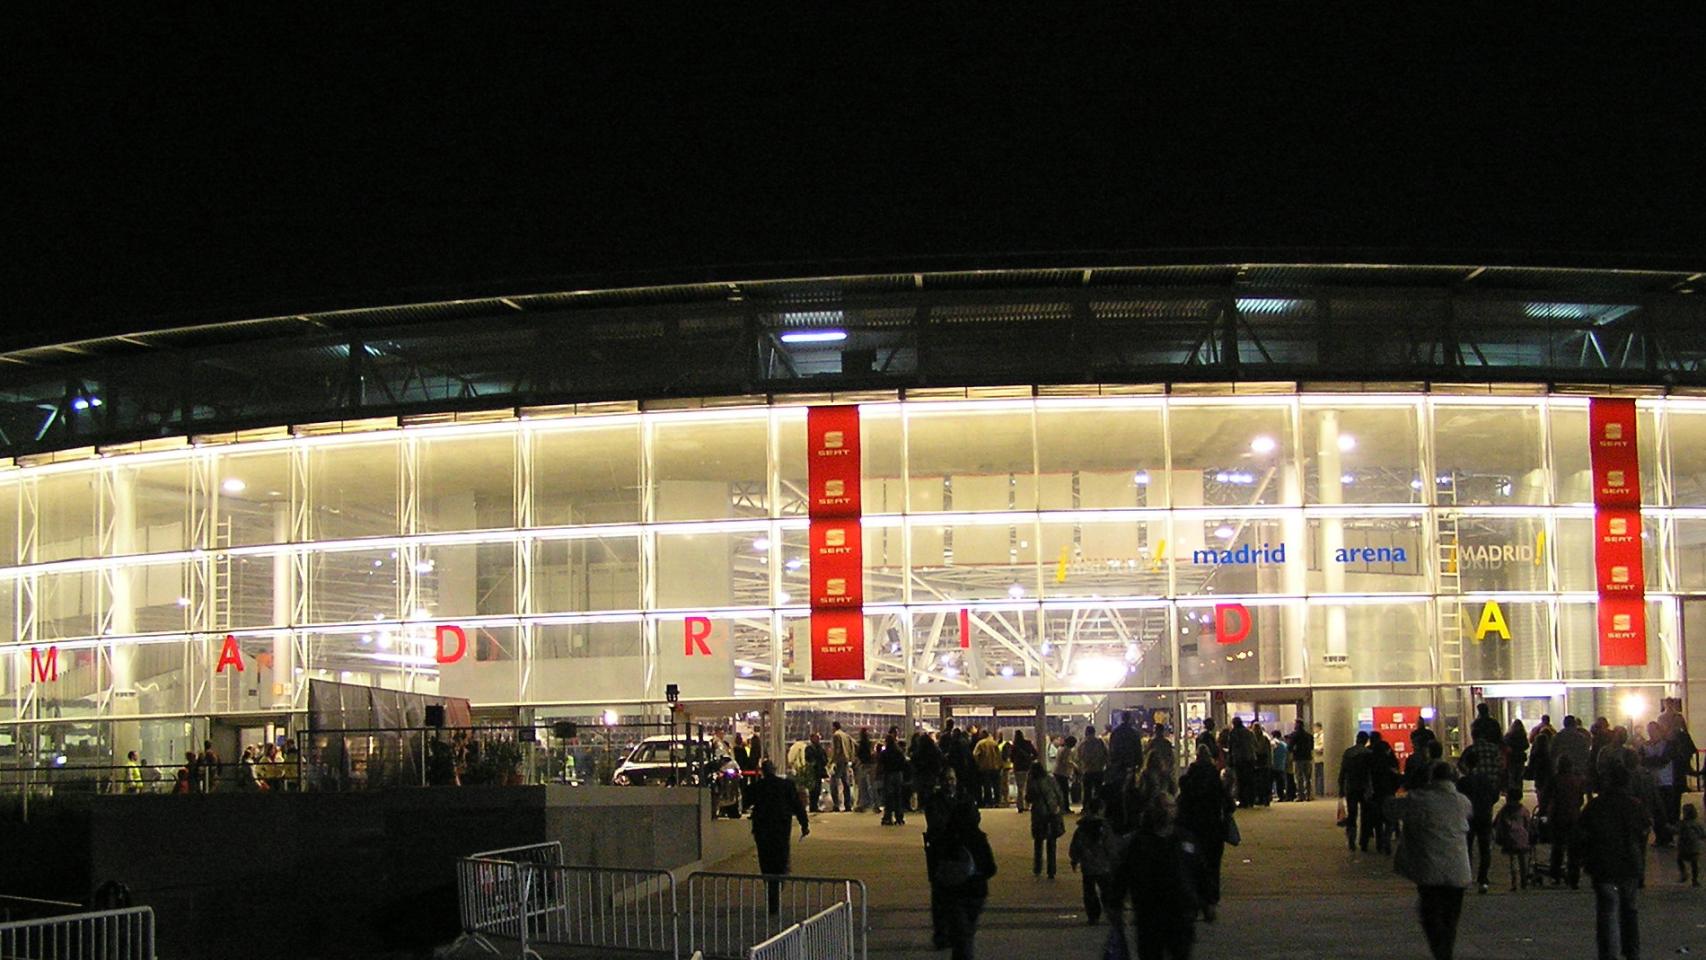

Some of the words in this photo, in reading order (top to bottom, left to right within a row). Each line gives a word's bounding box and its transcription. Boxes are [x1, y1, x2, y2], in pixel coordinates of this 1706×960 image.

[1193, 543, 1286, 565] madrid
[1336, 547, 1407, 564] arena
[1380, 722, 1417, 730] SEAT
